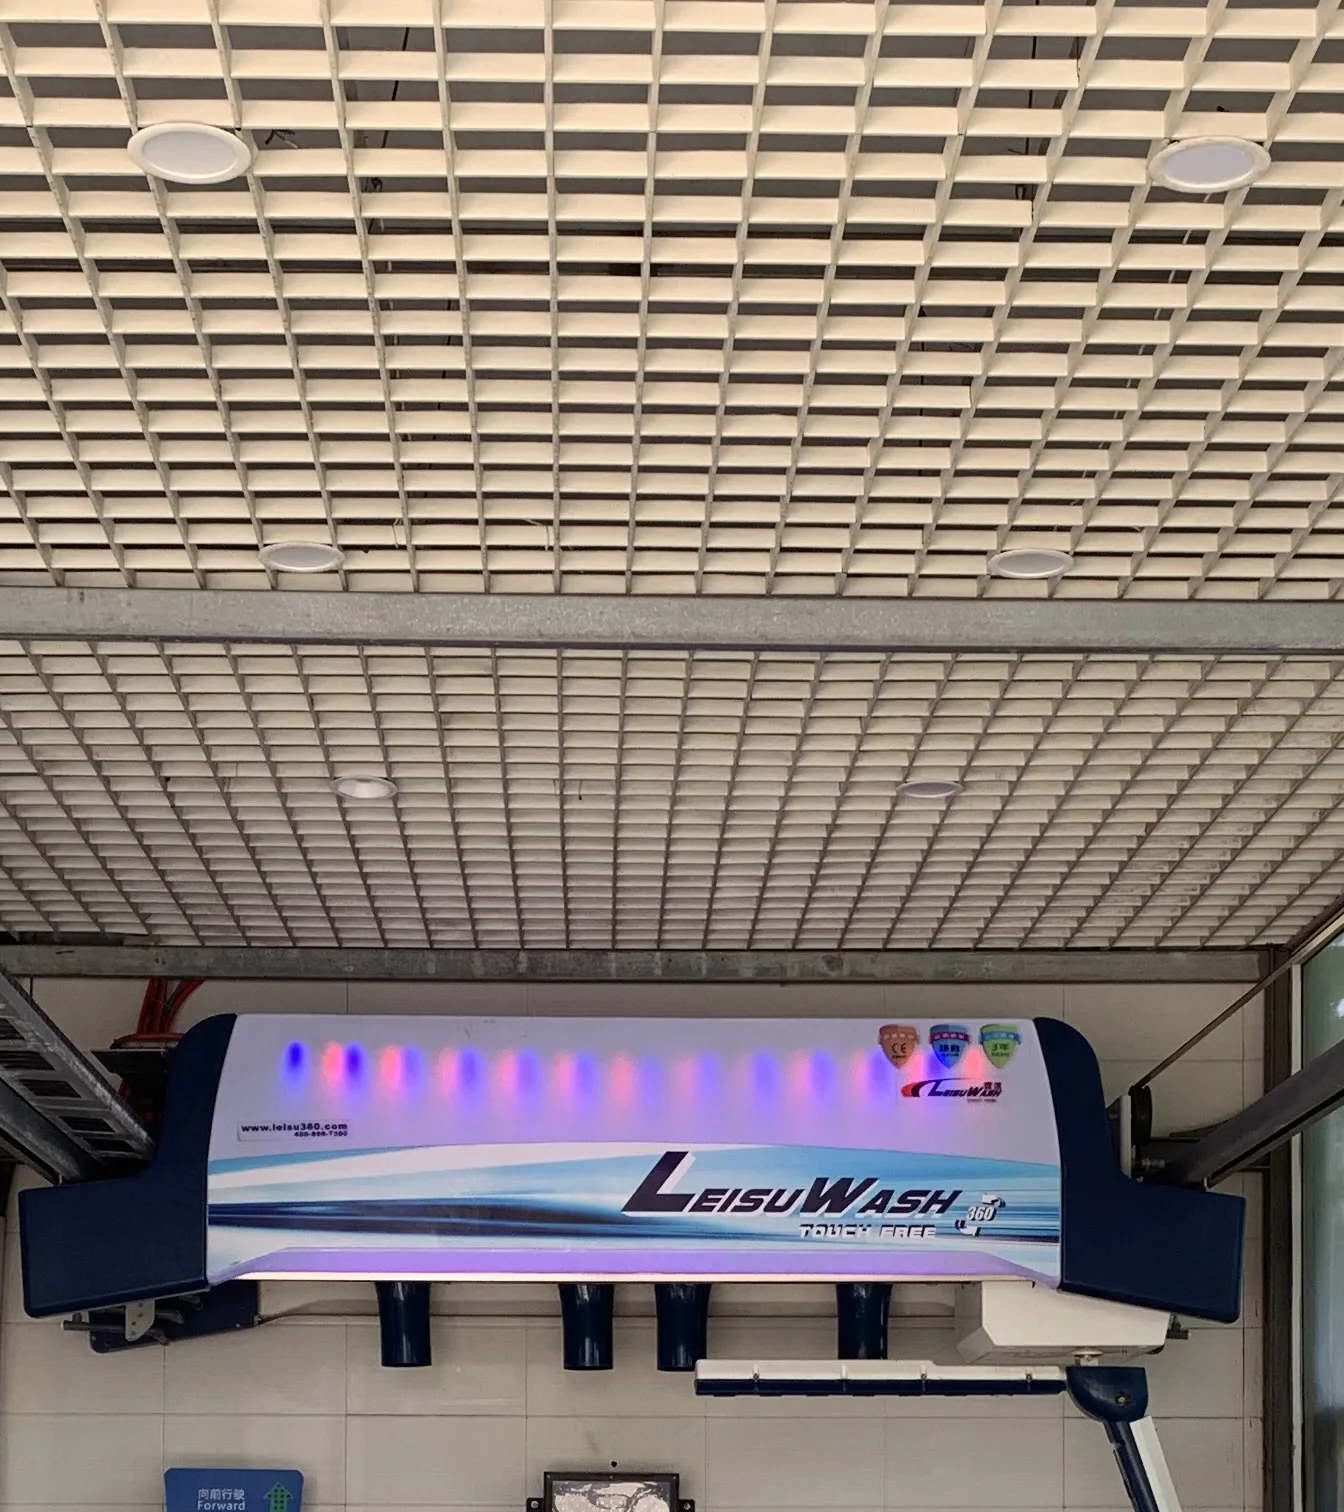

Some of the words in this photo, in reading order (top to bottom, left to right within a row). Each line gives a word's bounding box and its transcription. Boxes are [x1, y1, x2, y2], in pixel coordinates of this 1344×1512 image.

[967, 1206, 996, 1222] 360
[799, 1224, 872, 1238] TOUCH
[880, 1224, 937, 1238] FREE
[198, 1488, 245, 1500] 向前行驶
[197, 1501, 245, 1511] Forward
